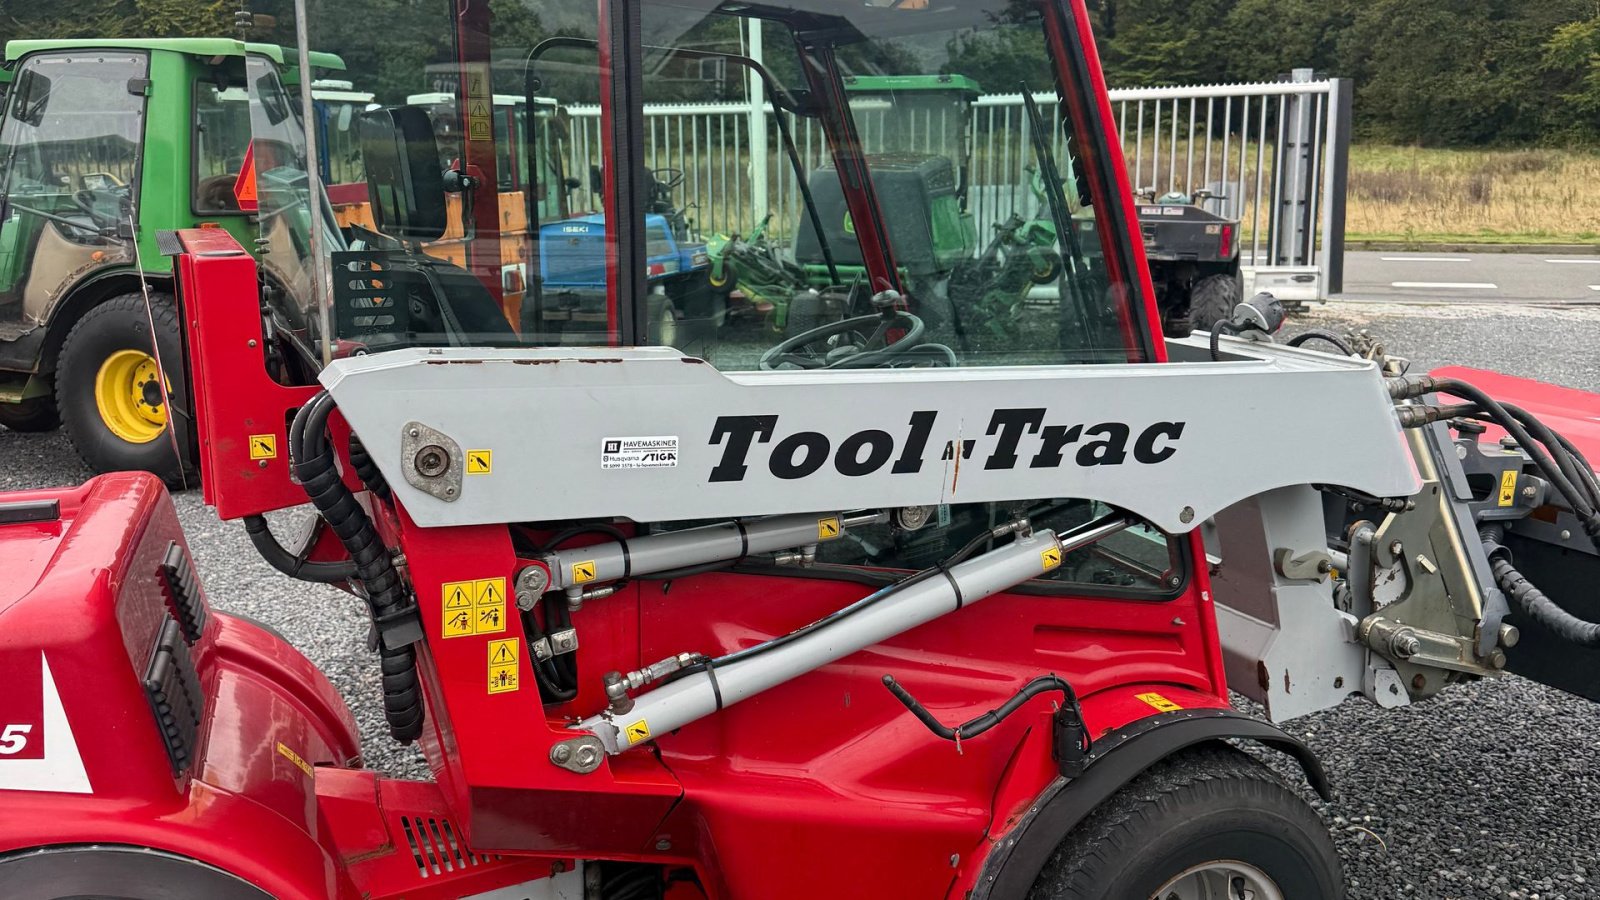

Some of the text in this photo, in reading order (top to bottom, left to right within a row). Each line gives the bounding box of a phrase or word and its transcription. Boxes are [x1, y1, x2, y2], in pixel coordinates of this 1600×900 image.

[623, 440, 677, 448] HAVEMASKINER
[641, 453, 677, 461] STIGA
[0, 724, 33, 755] 5
